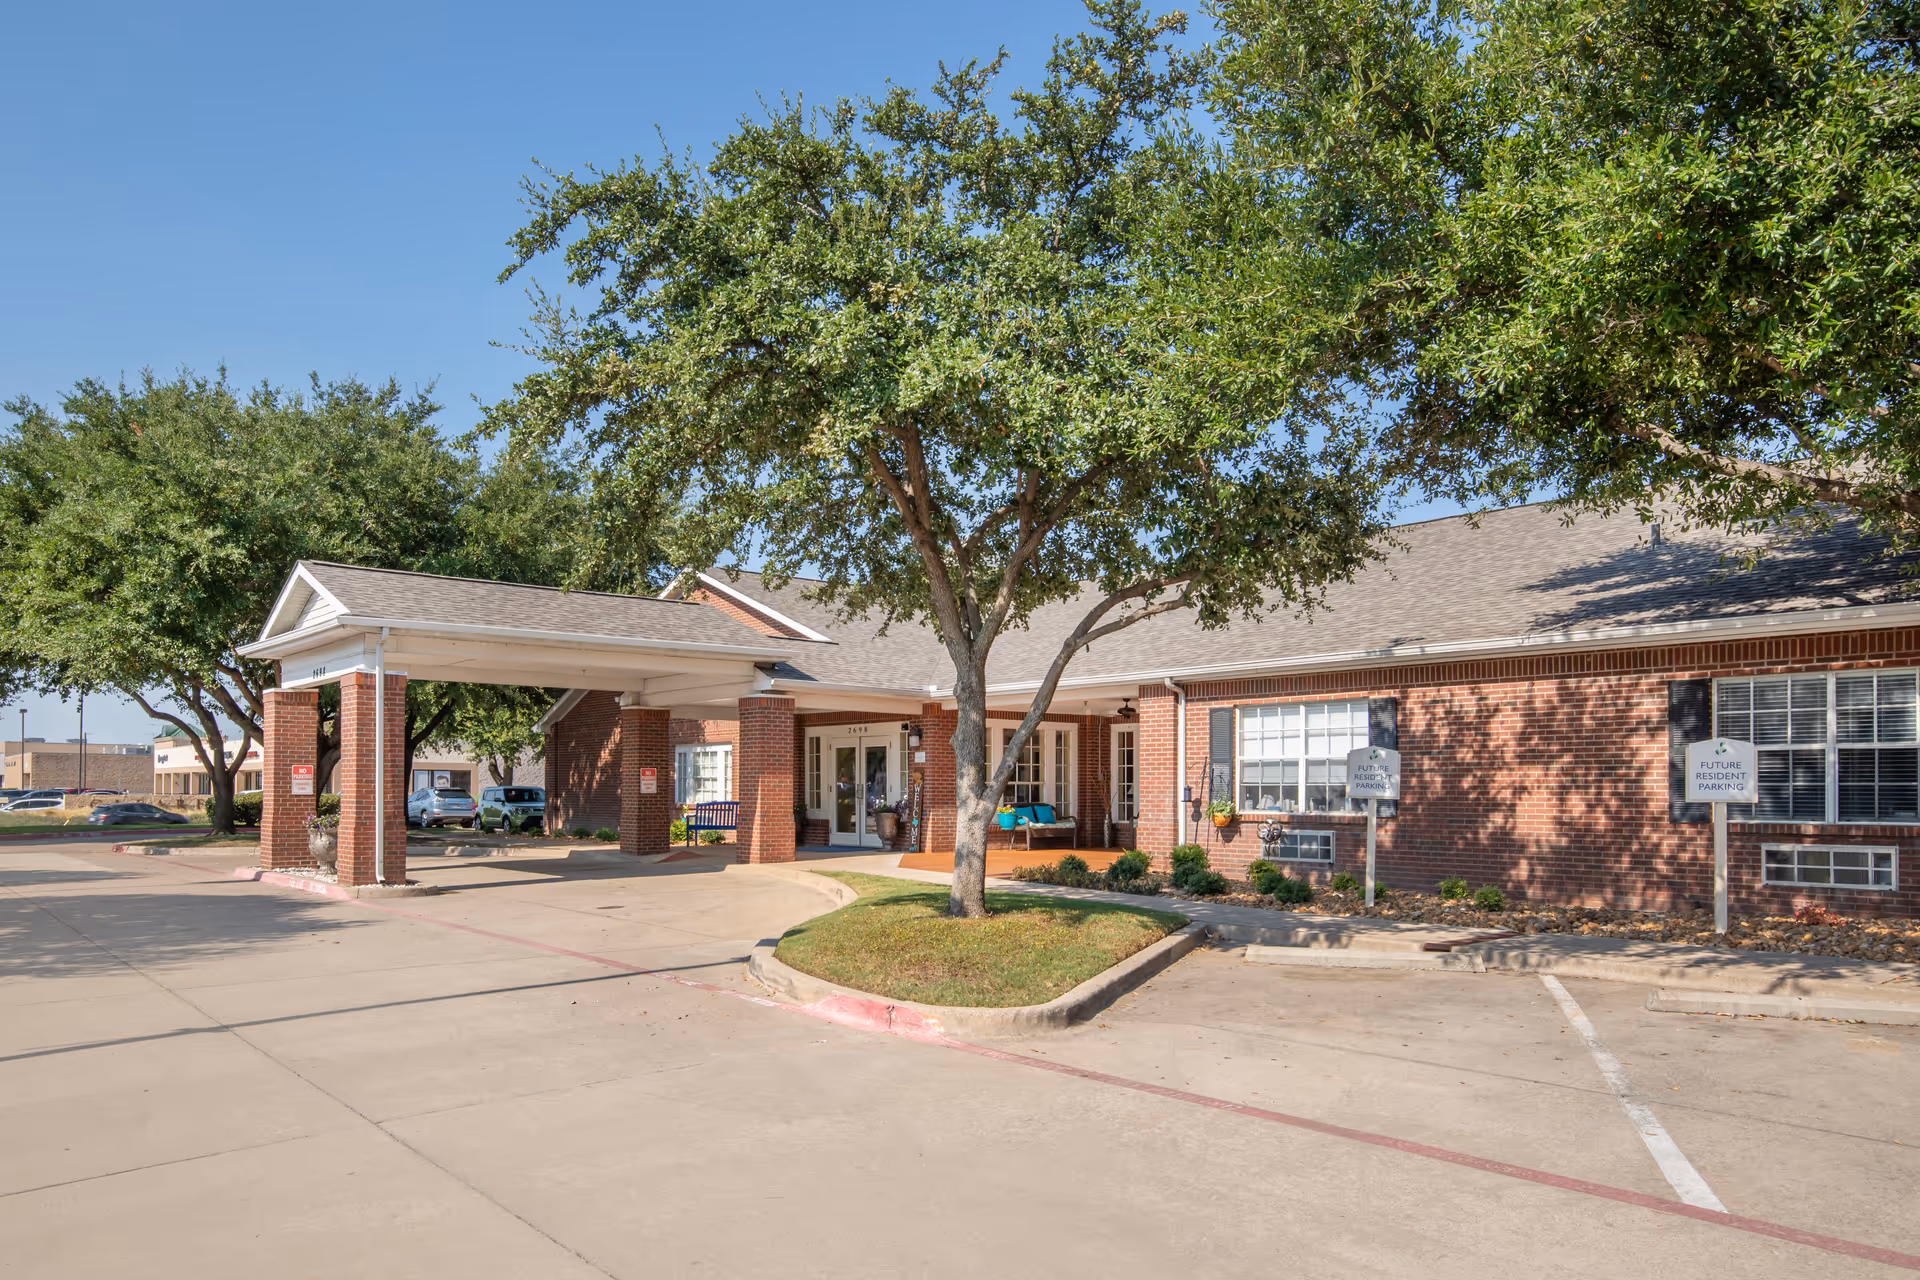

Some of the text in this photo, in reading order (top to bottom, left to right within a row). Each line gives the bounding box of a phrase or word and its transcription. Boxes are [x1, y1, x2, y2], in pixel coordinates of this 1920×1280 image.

[1700, 761, 1742, 769] FUTURE
[1696, 772, 1747, 780] RESIDENT
[1698, 783, 1744, 791] PARKING
[911, 784, 921, 844] WELCME
